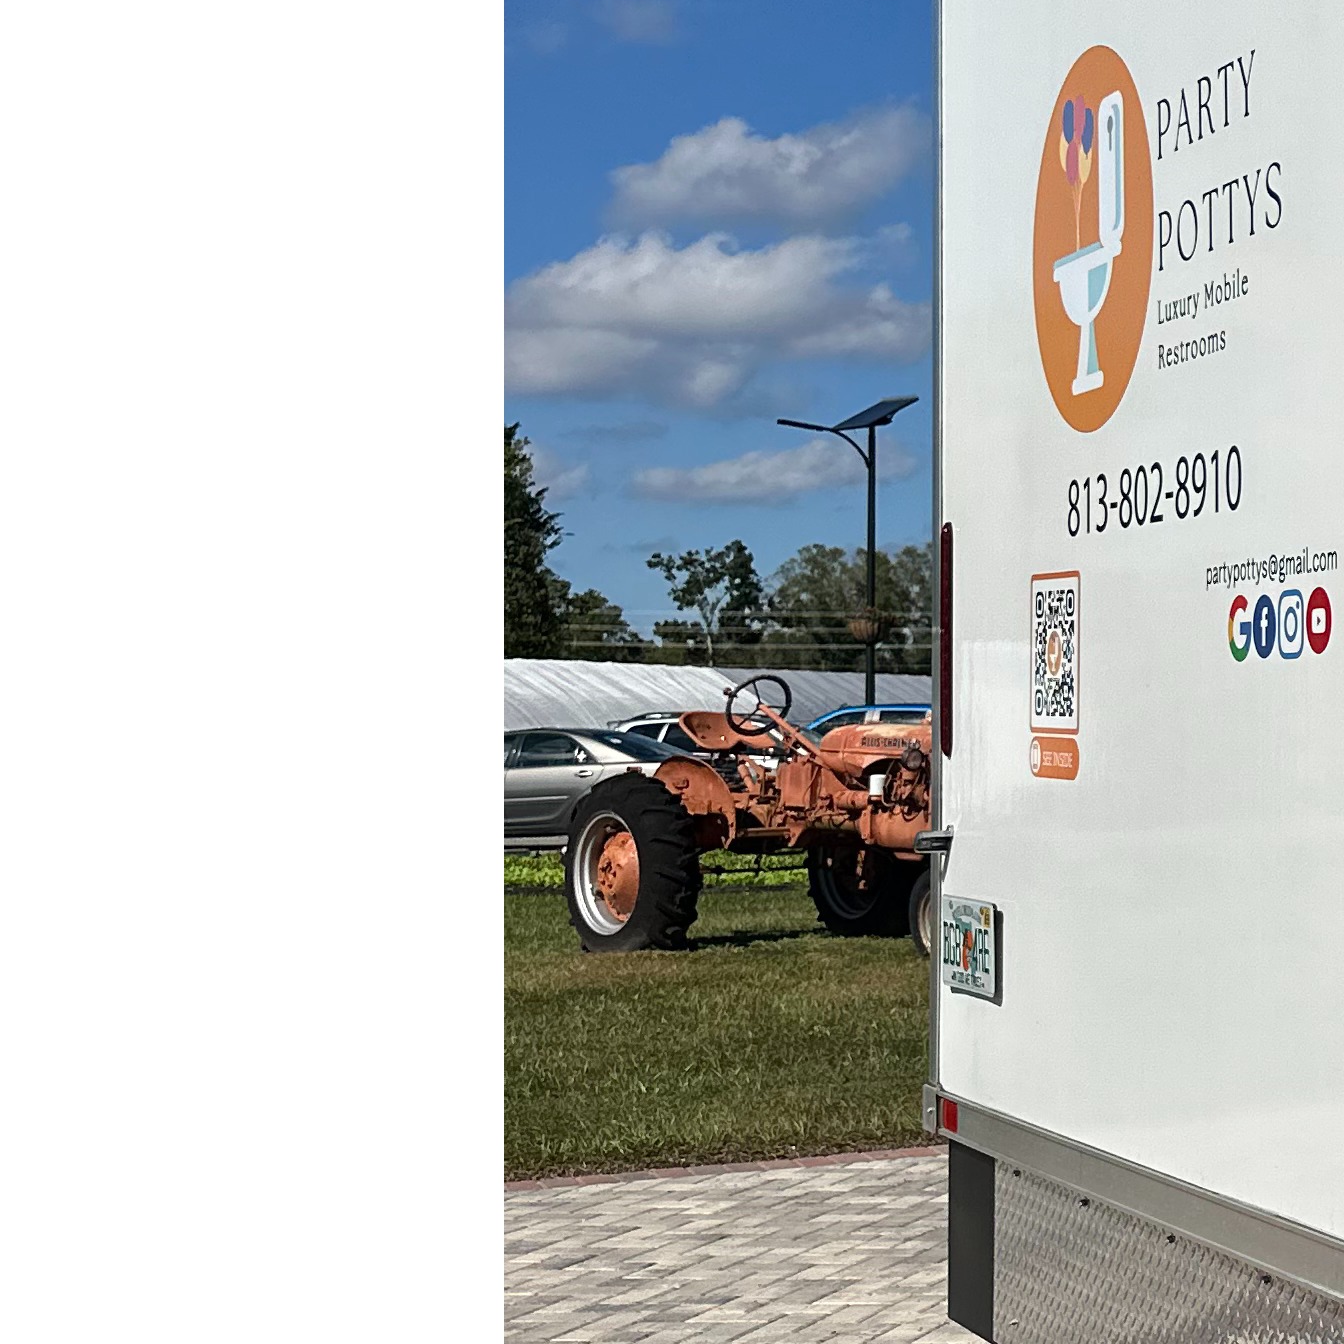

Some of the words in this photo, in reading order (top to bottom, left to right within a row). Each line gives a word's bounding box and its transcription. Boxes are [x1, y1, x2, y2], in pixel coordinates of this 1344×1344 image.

[1157, 48, 1256, 161] PARTY
[1158, 161, 1282, 272] POTTYS
[1157, 291, 1200, 326] Luxury
[1203, 267, 1249, 310] Mobile
[1158, 329, 1227, 370] Restrooms
[1067, 444, 1243, 538] 813-802-8910
[1205, 546, 1339, 592] partypottys@gmail.com
